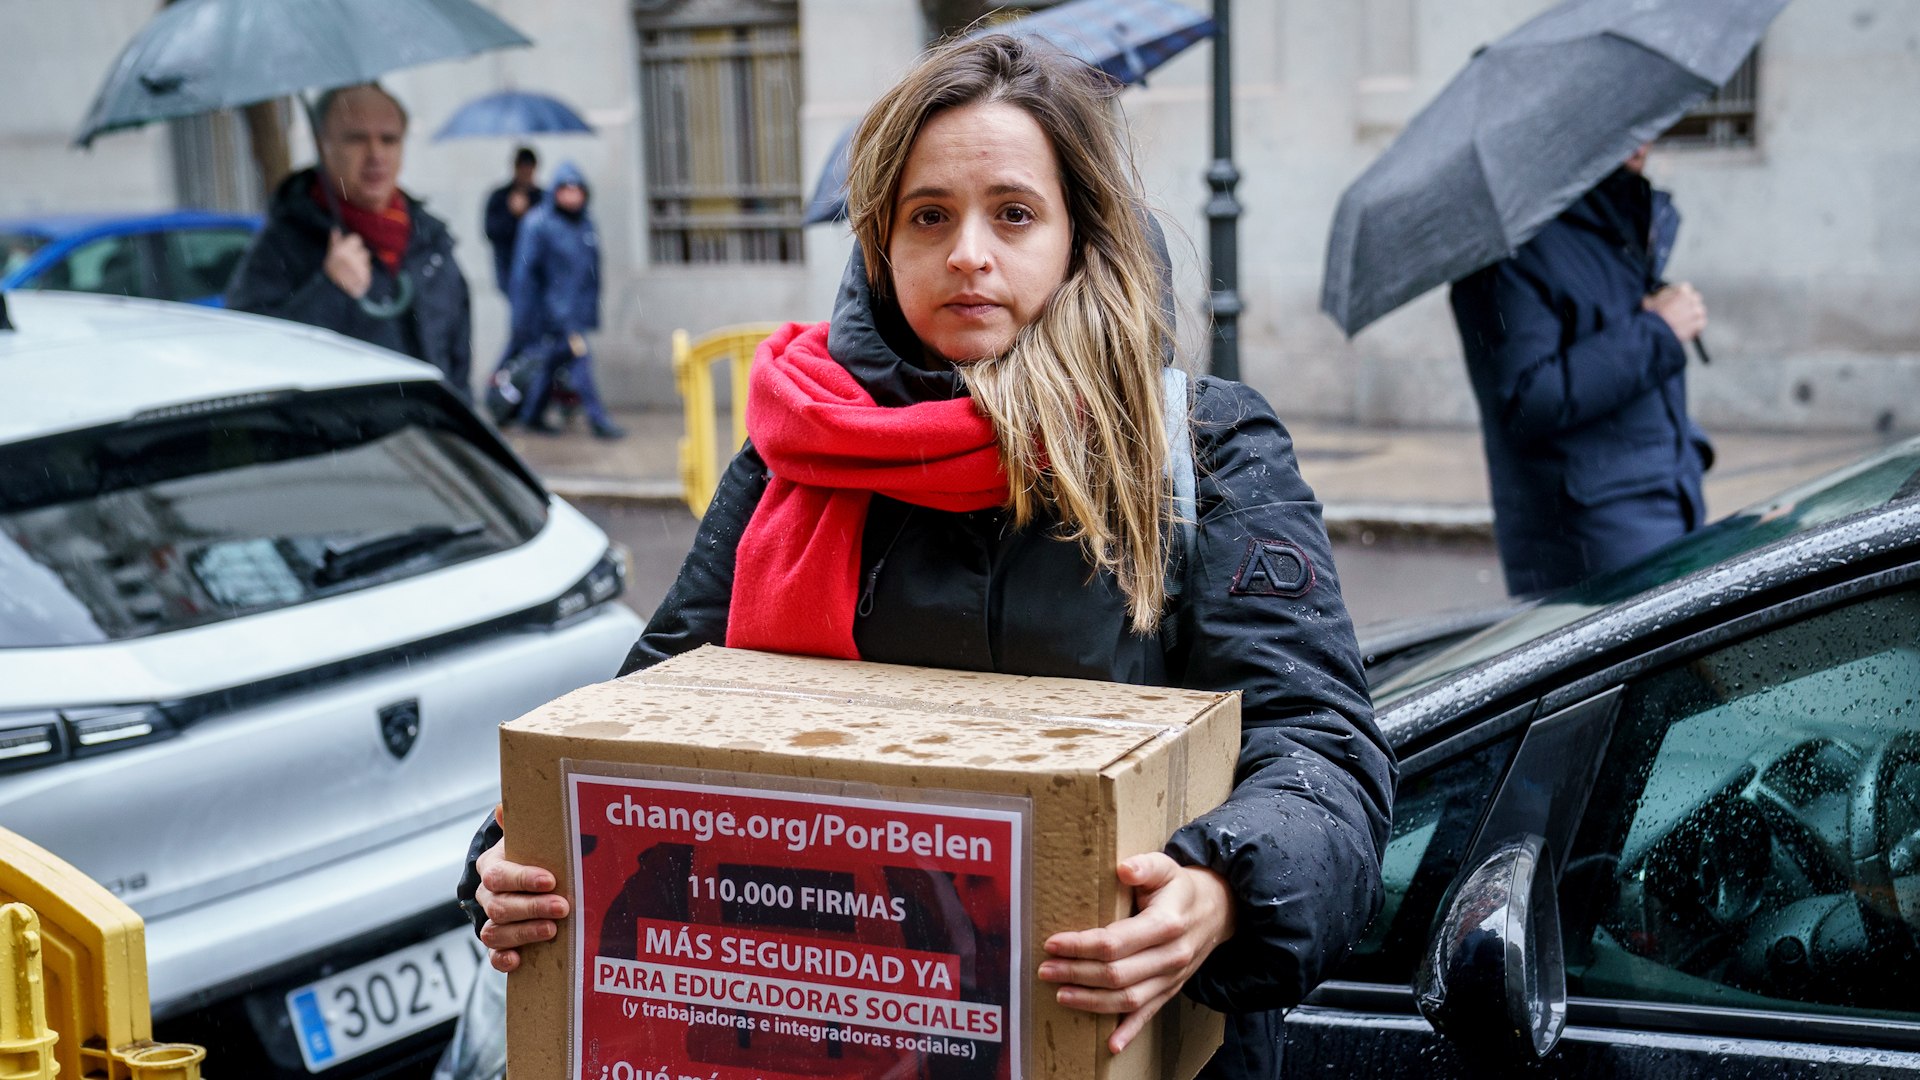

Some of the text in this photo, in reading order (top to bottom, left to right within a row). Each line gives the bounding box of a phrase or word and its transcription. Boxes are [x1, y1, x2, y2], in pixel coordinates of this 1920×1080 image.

[605, 794, 992, 862] change.org/PorBelen
[688, 875, 907, 922] 110.000 FIRMAS
[645, 926, 953, 991] MÁS SEGURIDAD YA
[333, 951, 457, 1039] 3021
[599, 963, 999, 1035] PARA EDUCADORAS SOCIALES
[622, 997, 977, 1060] (y trabajadoras e integradoras sociales)
